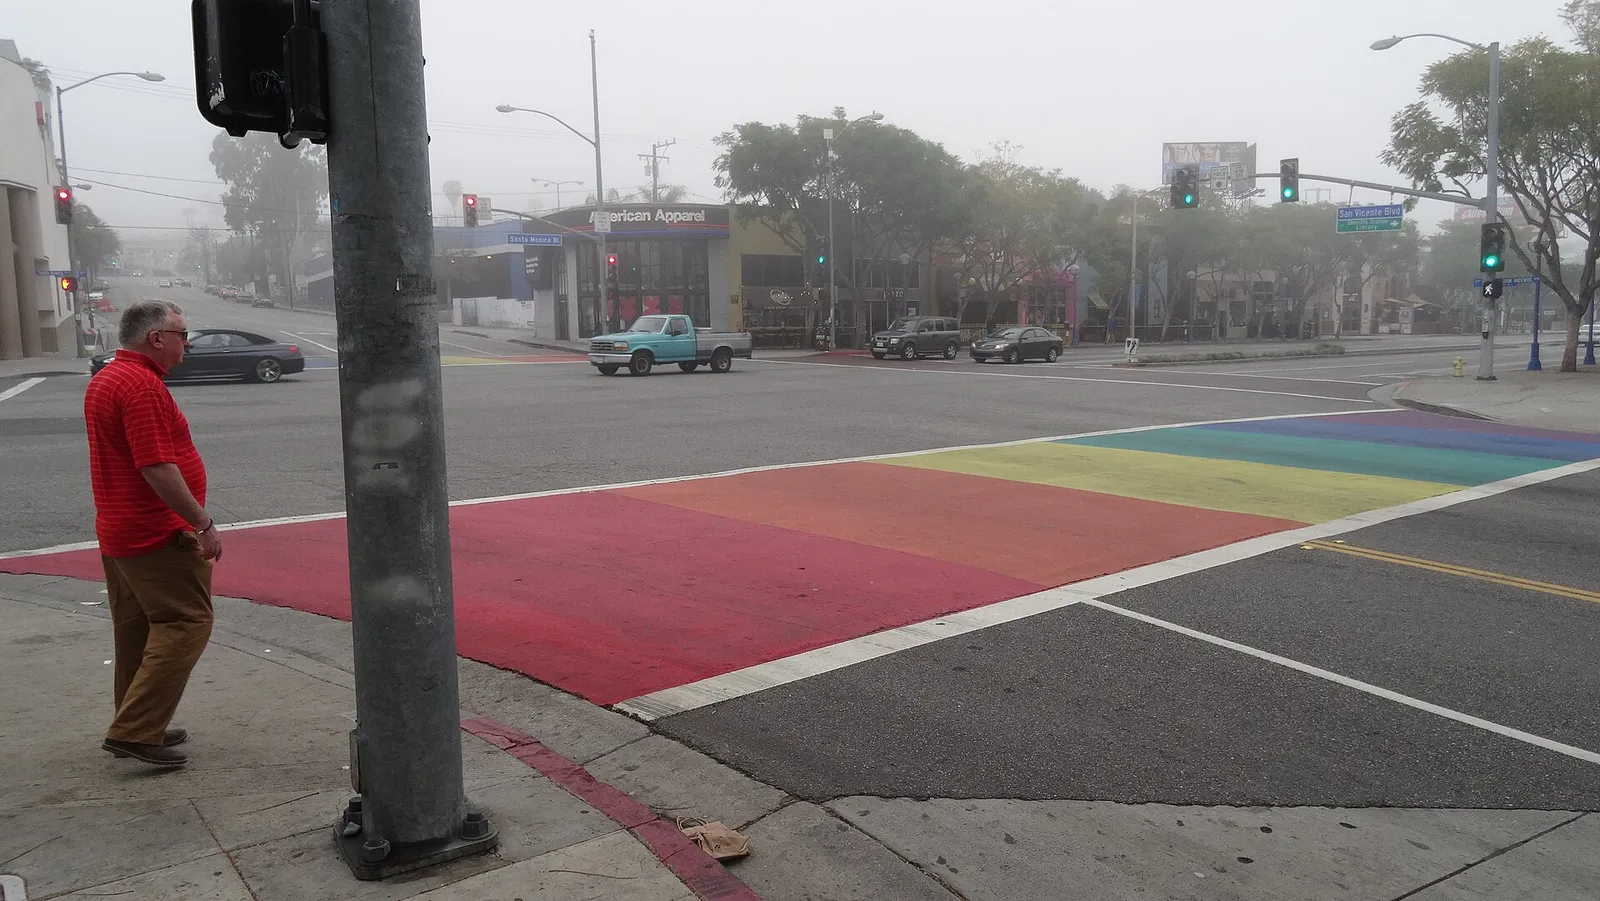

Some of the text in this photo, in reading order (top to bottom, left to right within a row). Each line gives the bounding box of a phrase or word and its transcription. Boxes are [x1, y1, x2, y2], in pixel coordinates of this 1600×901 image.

[589, 210, 652, 223] Aerican
[655, 209, 705, 223] Apparel
[1340, 207, 1400, 218] San Vicente Blvd
[510, 235, 528, 243] Santa
